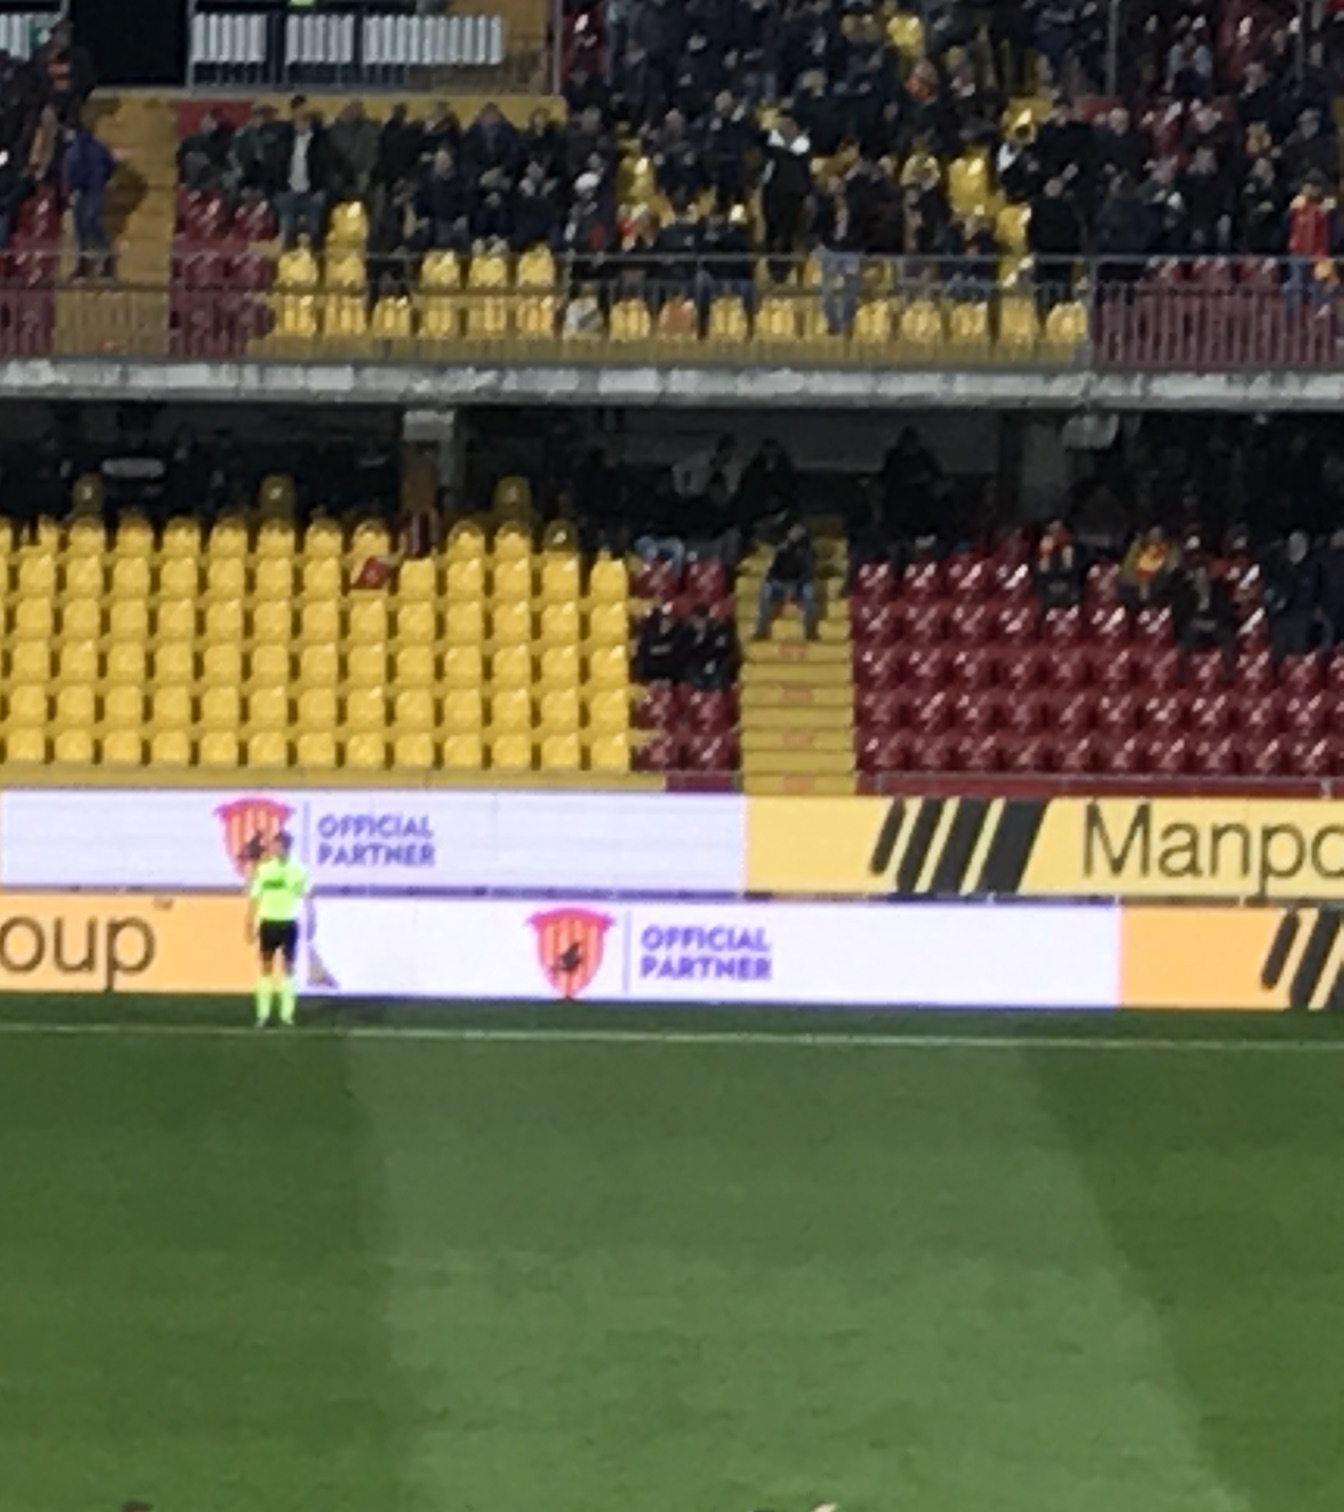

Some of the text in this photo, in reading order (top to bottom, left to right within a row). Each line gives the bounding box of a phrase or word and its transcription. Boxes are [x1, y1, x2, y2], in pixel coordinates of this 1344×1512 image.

[317, 814, 433, 839] OFFICIAL
[317, 842, 435, 867] PARTNER
[1083, 800, 1344, 897] Manpo
[640, 924, 769, 951] OFFICIAL
[640, 955, 771, 980] PARTNER
